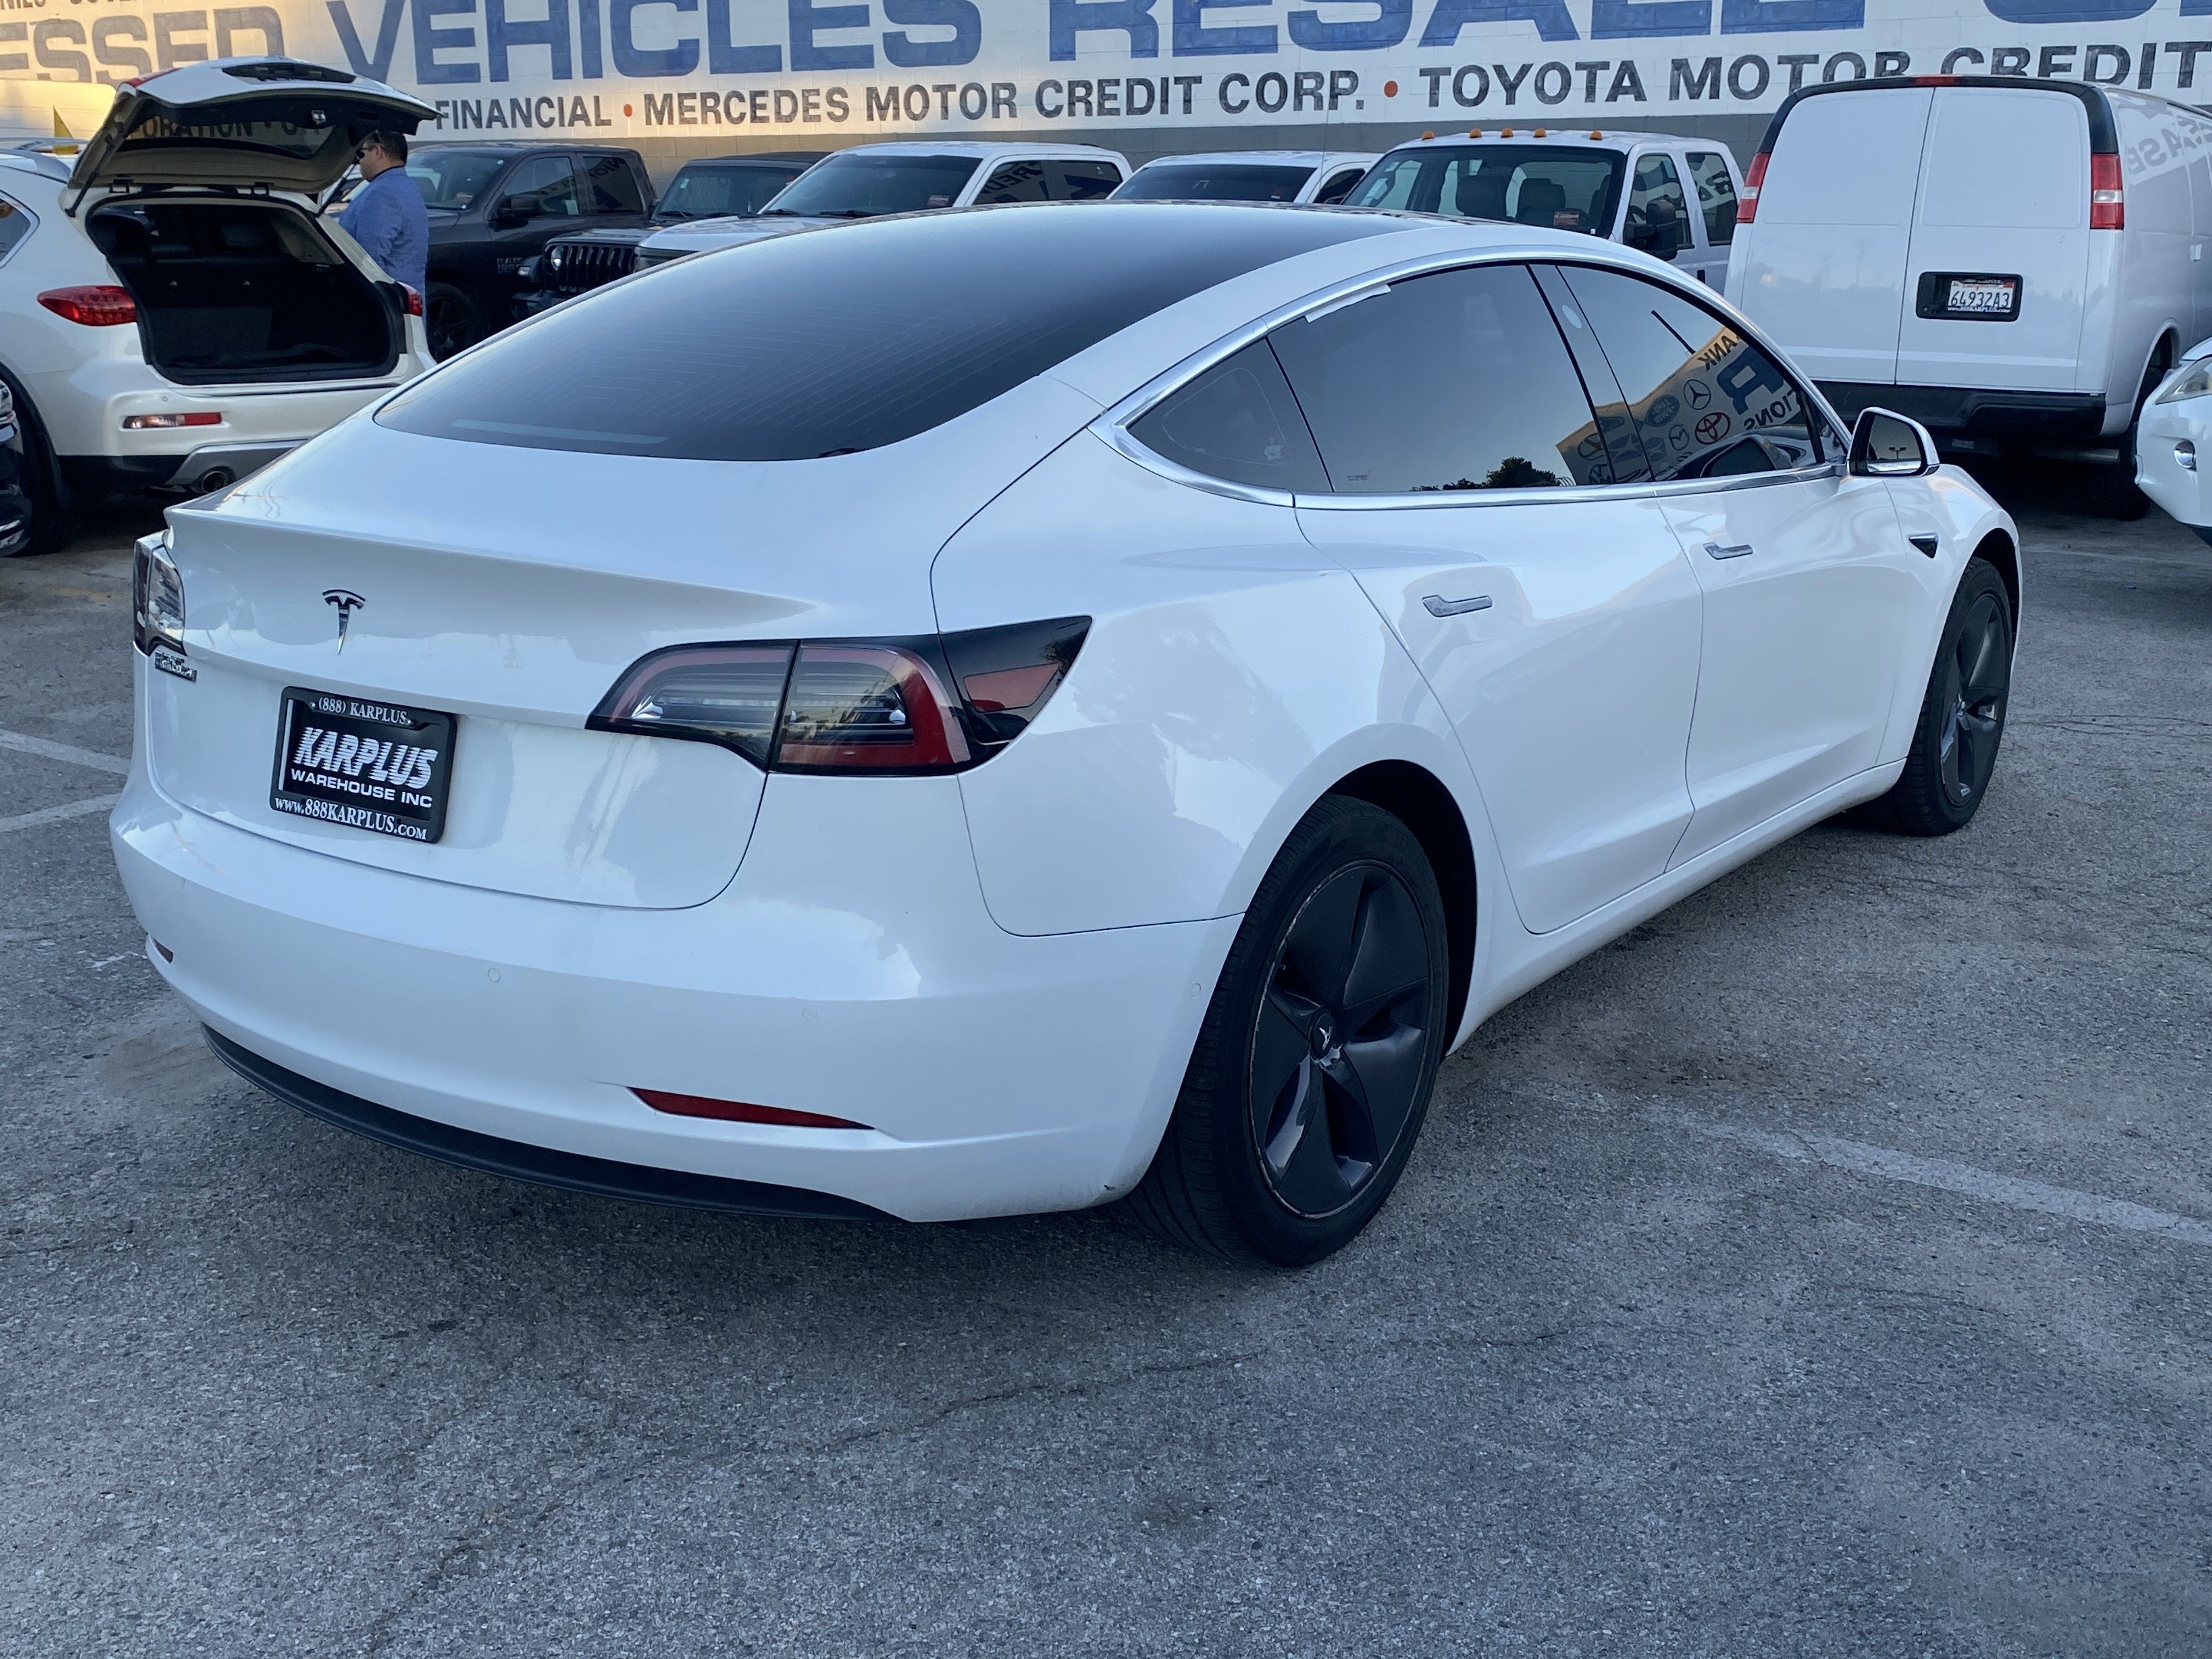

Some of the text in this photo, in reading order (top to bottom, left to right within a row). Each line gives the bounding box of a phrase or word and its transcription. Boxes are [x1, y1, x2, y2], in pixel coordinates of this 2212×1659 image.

[327, 0, 981, 84] VEHICLES
[435, 41, 2212, 130] FINANCIAL MERCEDES MOTOR CREDIT CORP. TOYOTA MOTOR CREDIT
[1951, 291, 2010, 308] 64932A3
[319, 697, 347, 714] (888)
[293, 726, 438, 789] KARPLUS
[291, 768, 432, 808] WAREHOUSE INC
